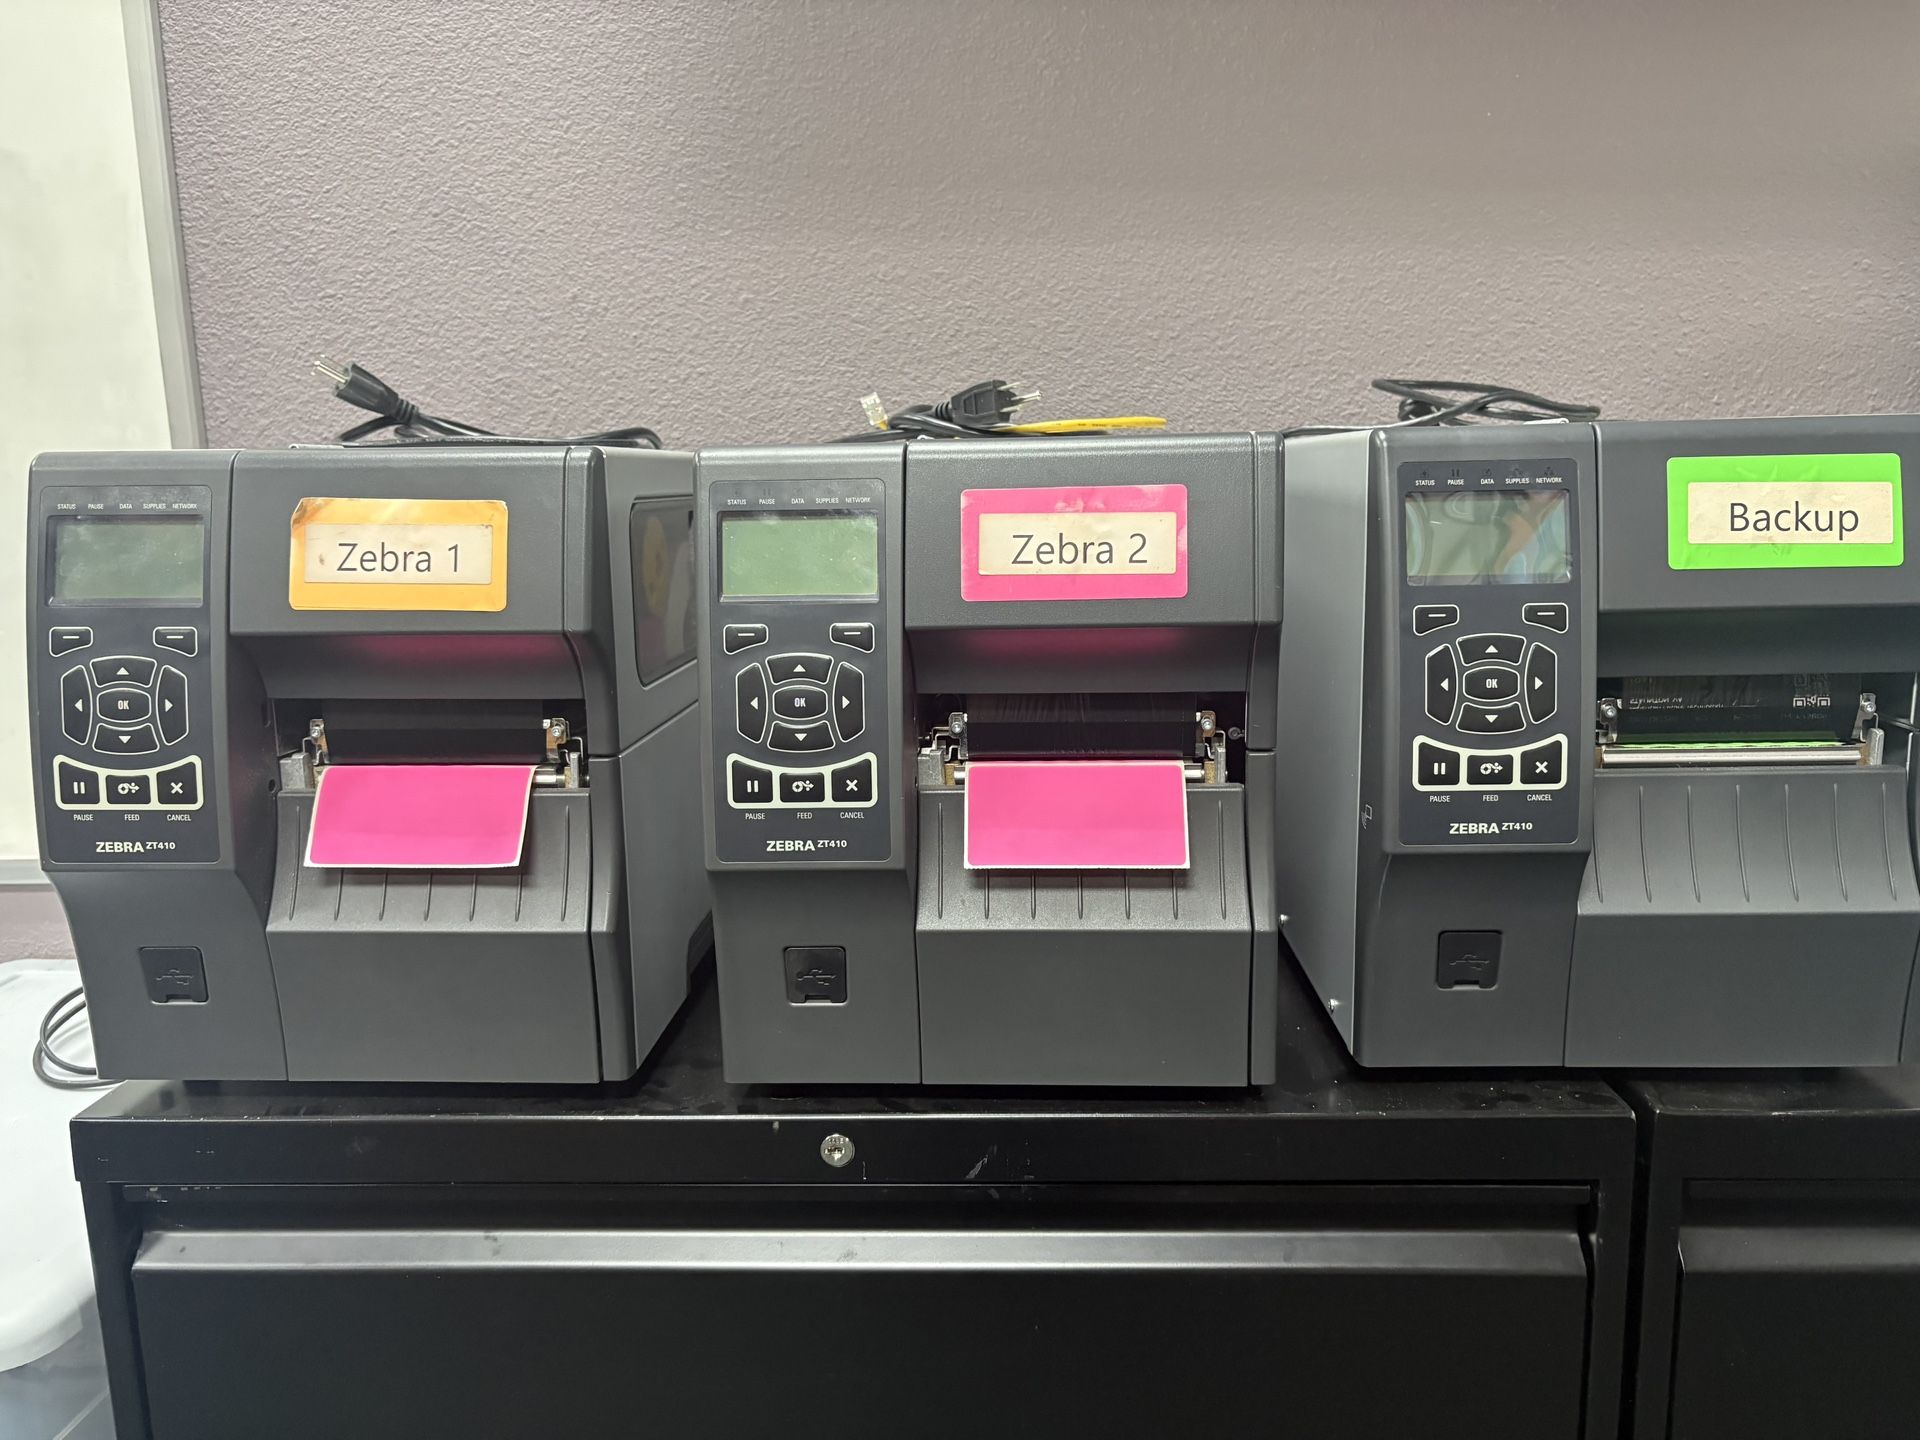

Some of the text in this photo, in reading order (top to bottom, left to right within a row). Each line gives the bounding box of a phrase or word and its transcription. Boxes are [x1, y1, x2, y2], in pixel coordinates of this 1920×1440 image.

[1447, 478, 1465, 486] PAUSE
[1505, 477, 1530, 485] SUPPLIES
[1535, 476, 1562, 484] NETWORK
[727, 498, 747, 506] STATUS
[791, 497, 805, 505] DATA
[1730, 501, 1859, 541] Backup
[1012, 533, 1147, 564] Zebra 2
[337, 542, 458, 572] Zebra 1
[1485, 678, 1498, 689] OK
[117, 699, 130, 710] OK
[794, 697, 806, 708] OK
[1429, 795, 1451, 803] PAUSE
[1482, 794, 1499, 802] FEED
[1526, 793, 1553, 802] CANCEL
[73, 813, 94, 822] PAUSE
[124, 813, 140, 821] FEED
[166, 814, 192, 822] CANCEL
[745, 812, 766, 820] PAUSE
[796, 811, 813, 820] FEED
[839, 811, 865, 819] CANCEL
[1449, 822, 1533, 835] ZEBRA ZT410
[95, 841, 176, 853] ZEBRA ZT410
[766, 839, 848, 852] ZEBRA ZT410
